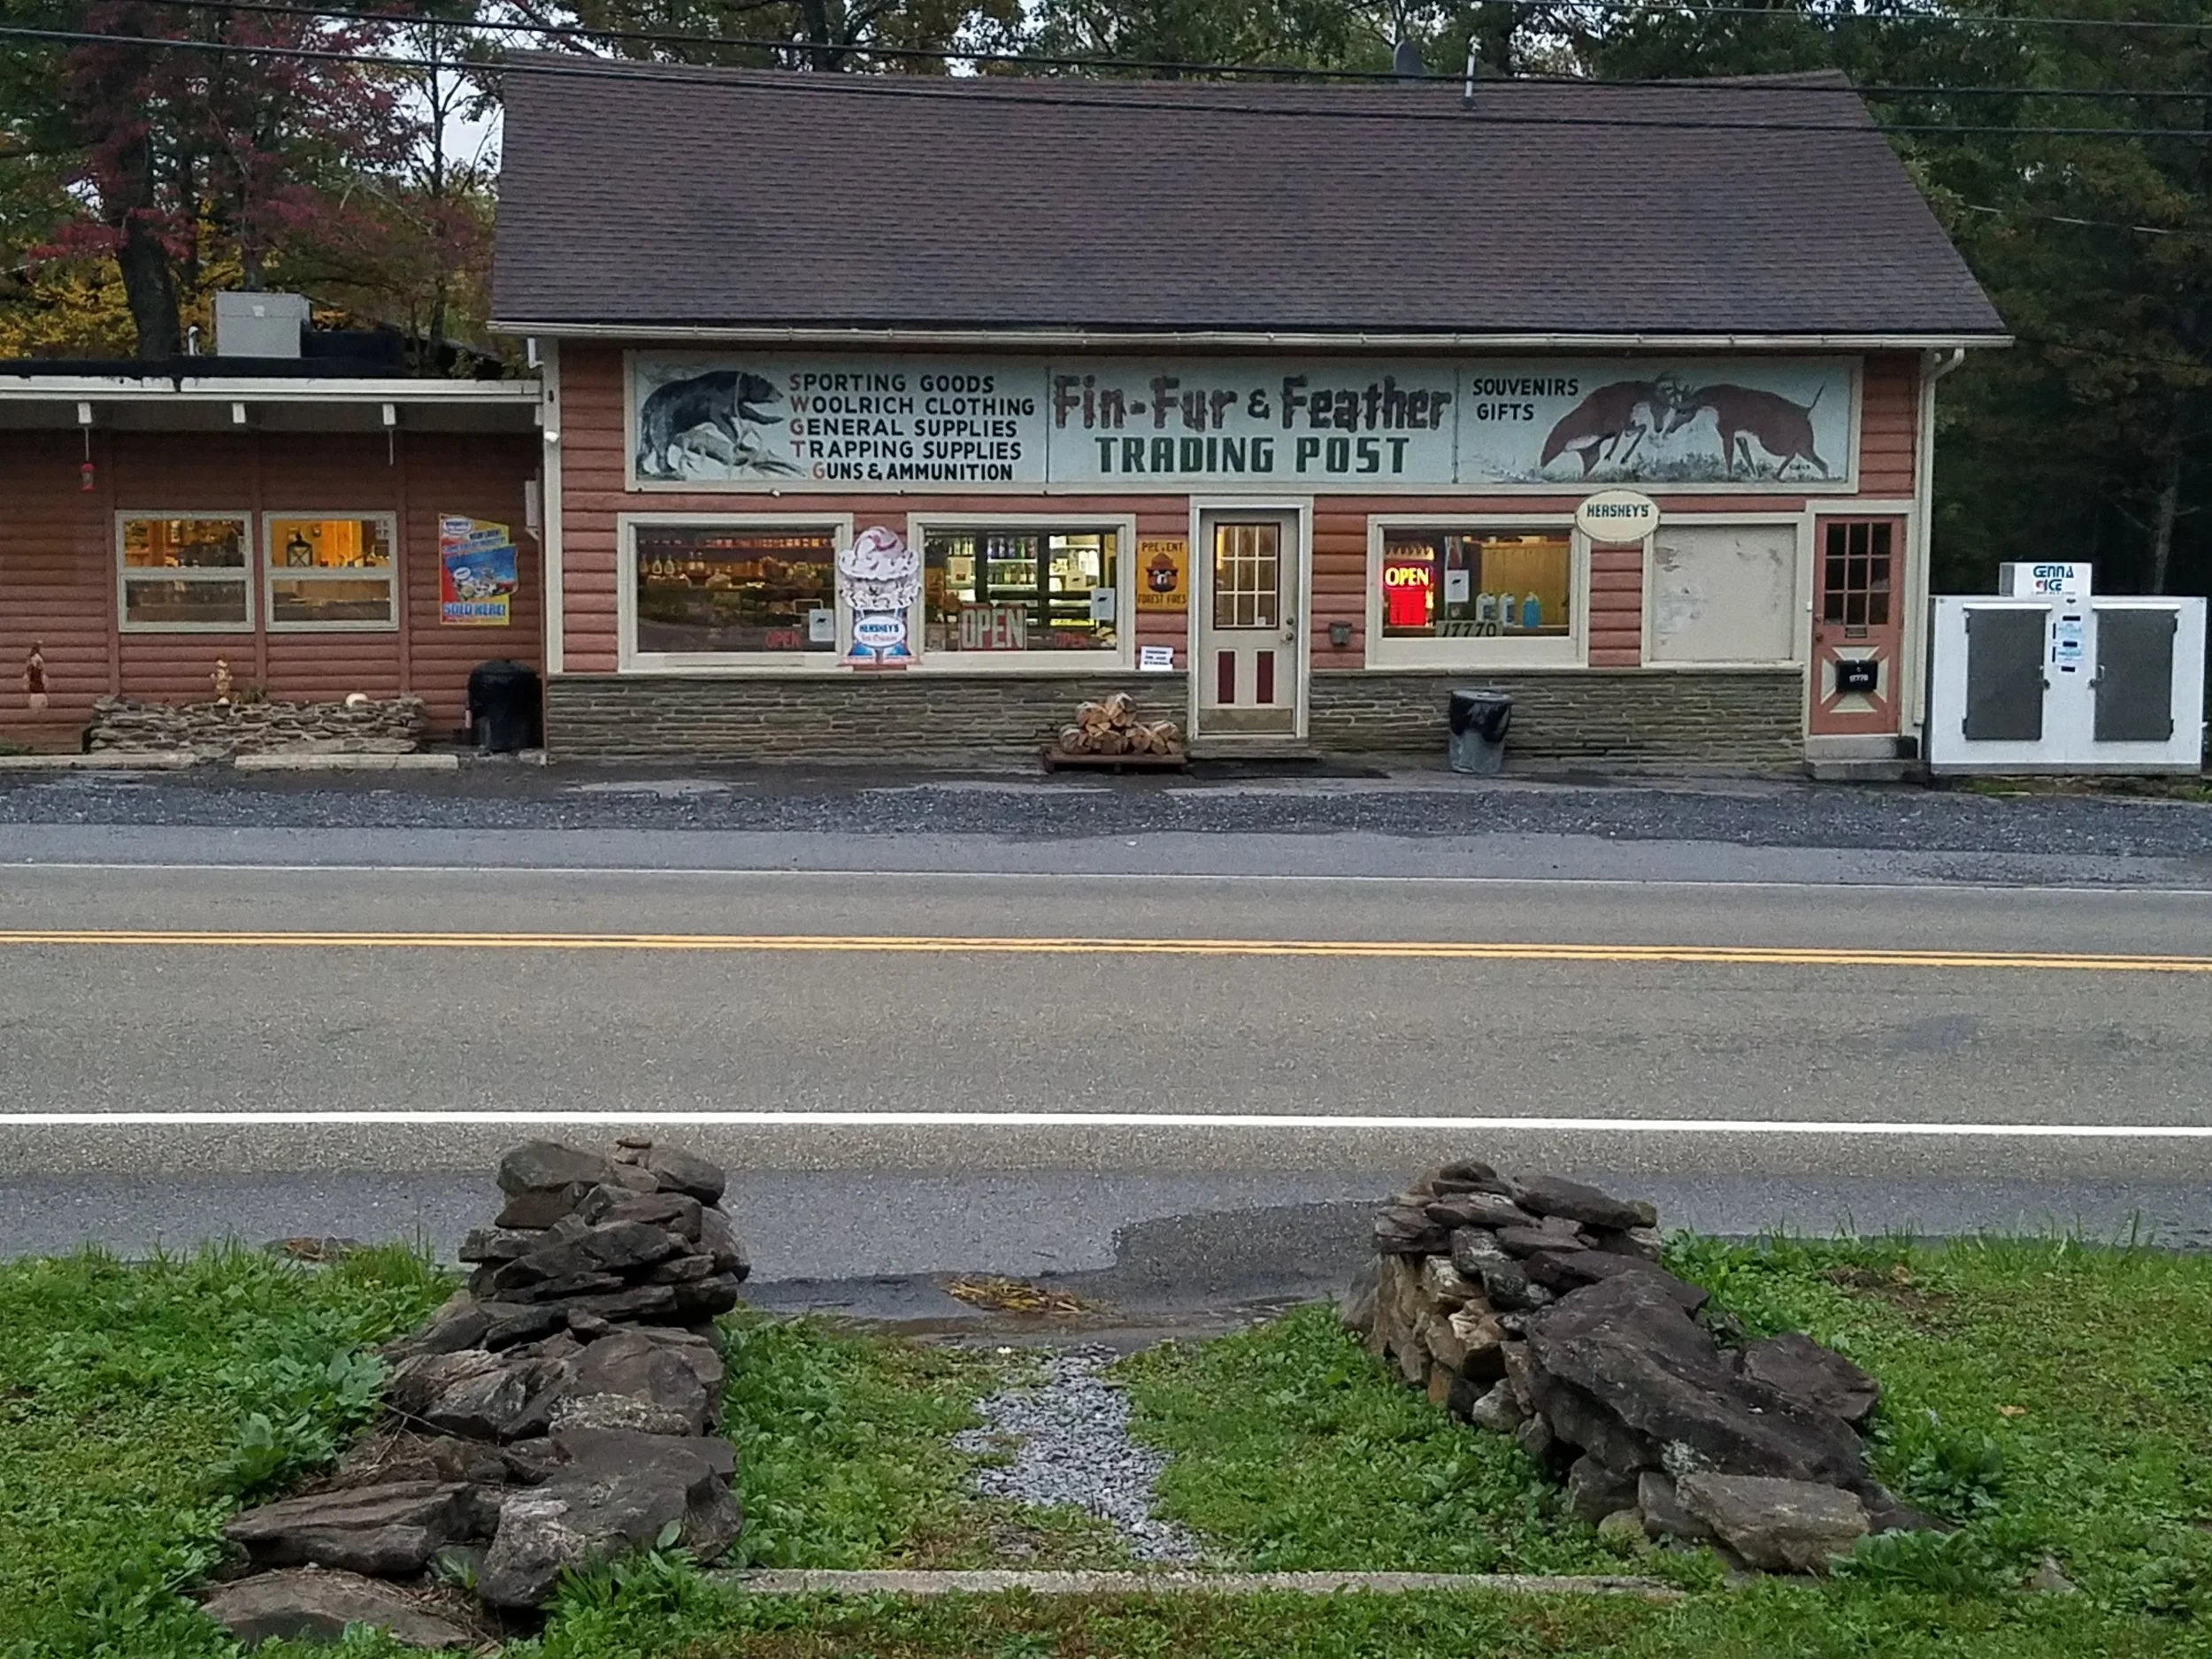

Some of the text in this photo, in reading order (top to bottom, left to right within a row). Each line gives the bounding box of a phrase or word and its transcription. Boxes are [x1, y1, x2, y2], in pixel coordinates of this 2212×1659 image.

[789, 373, 995, 394] SPORTING GOODS
[1472, 378, 1578, 396] SOUVENIRS
[790, 396, 1035, 417] WOOLRICH CLOTHING
[1053, 374, 1452, 432] Fin-Fur & Feather
[1477, 403, 1534, 420] GIFTS
[789, 418, 1017, 438] GENERAL SUPPLIES
[789, 440, 1022, 460] TRAPPING SUPPLIES
[1094, 436, 1409, 473] TRADING POST
[886, 462, 1012, 480] AMMUNITION
[1586, 503, 1650, 518] HERSHEY'S
[1385, 567, 1430, 587] OPEN
[961, 608, 1024, 649] OPEN
[1441, 621, 1497, 637] 17770
